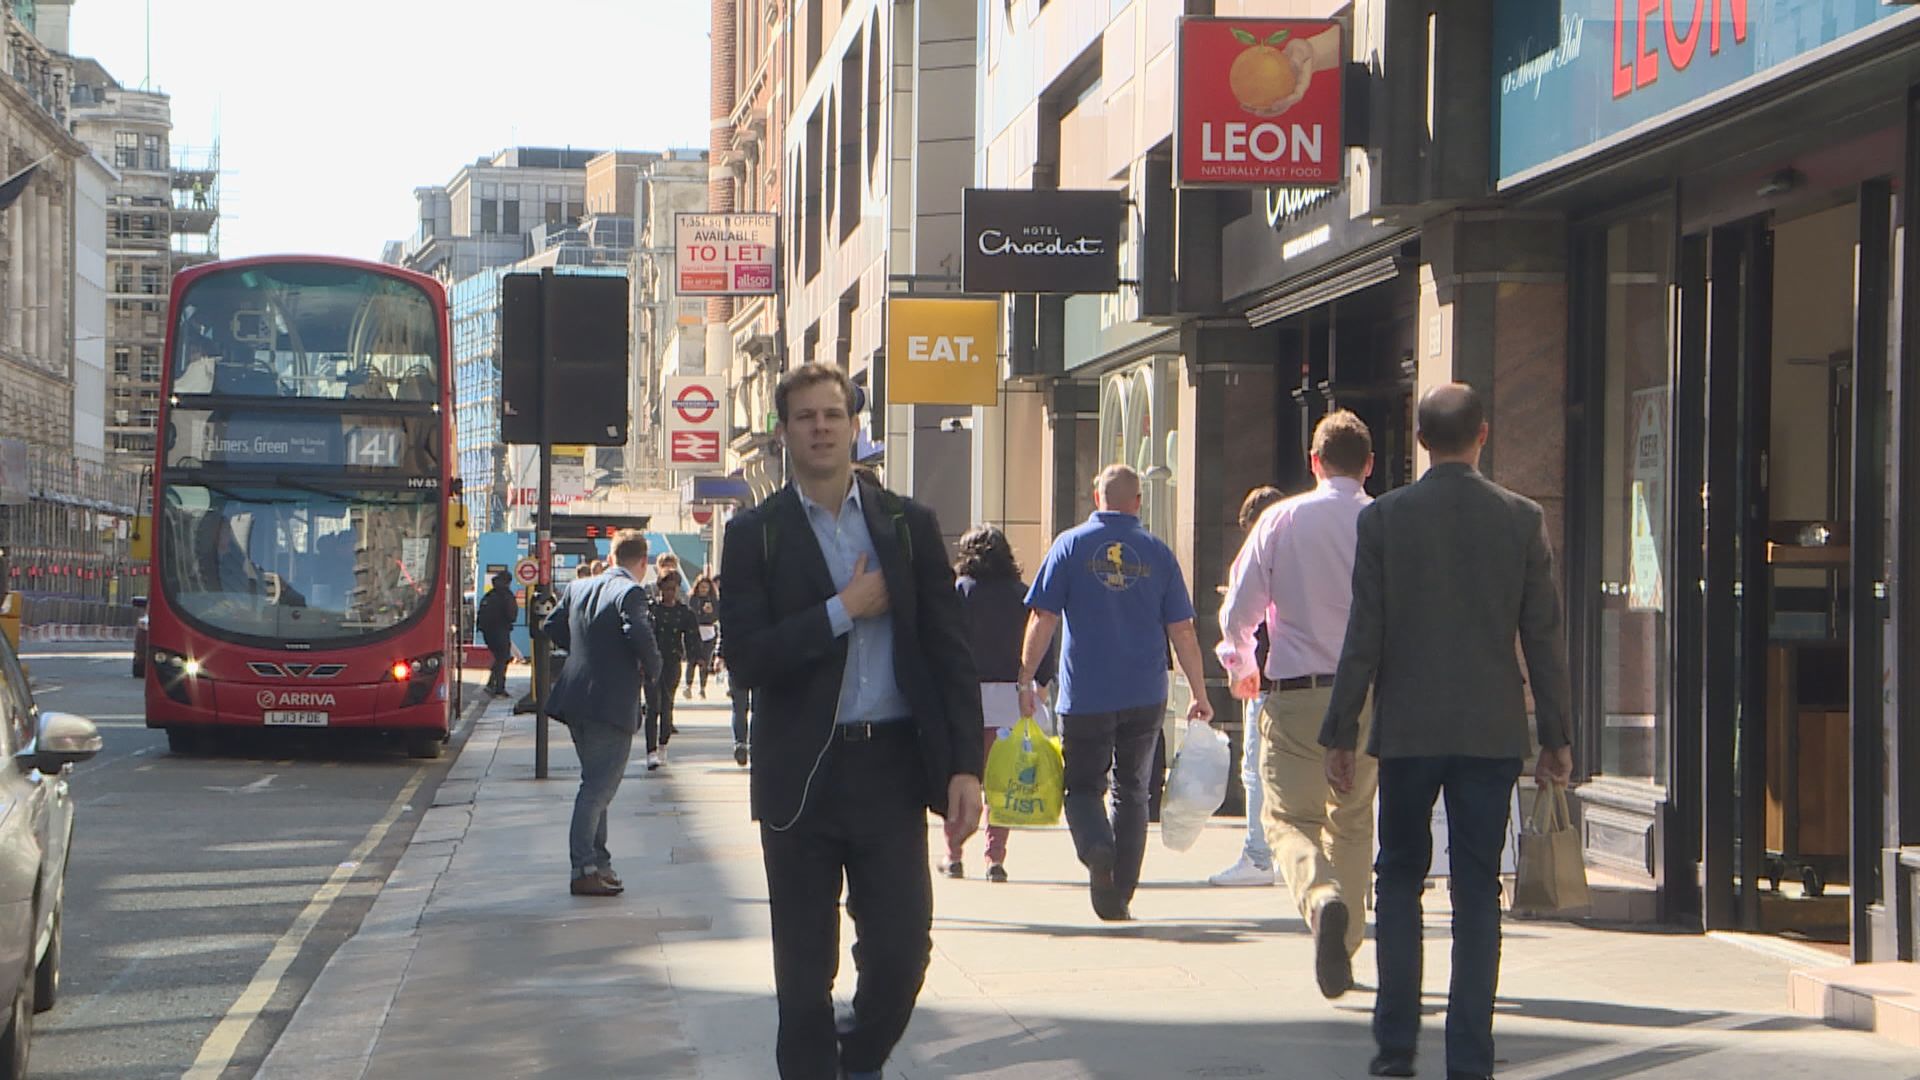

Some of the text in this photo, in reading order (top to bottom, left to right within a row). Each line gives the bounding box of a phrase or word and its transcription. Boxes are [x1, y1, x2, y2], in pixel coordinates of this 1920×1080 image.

[1202, 122, 1322, 162] LEON
[1201, 165, 1322, 177] NATURALLY FAST FOOD
[734, 216, 772, 227] OFFICE
[694, 230, 759, 242] AVAILABLE
[1023, 226, 1060, 236] HOTEL
[687, 245, 767, 262] TO LET
[908, 336, 979, 363] EAT.
[254, 436, 289, 454] Green
[350, 433, 395, 465] 141
[279, 693, 336, 706] ARRIVA
